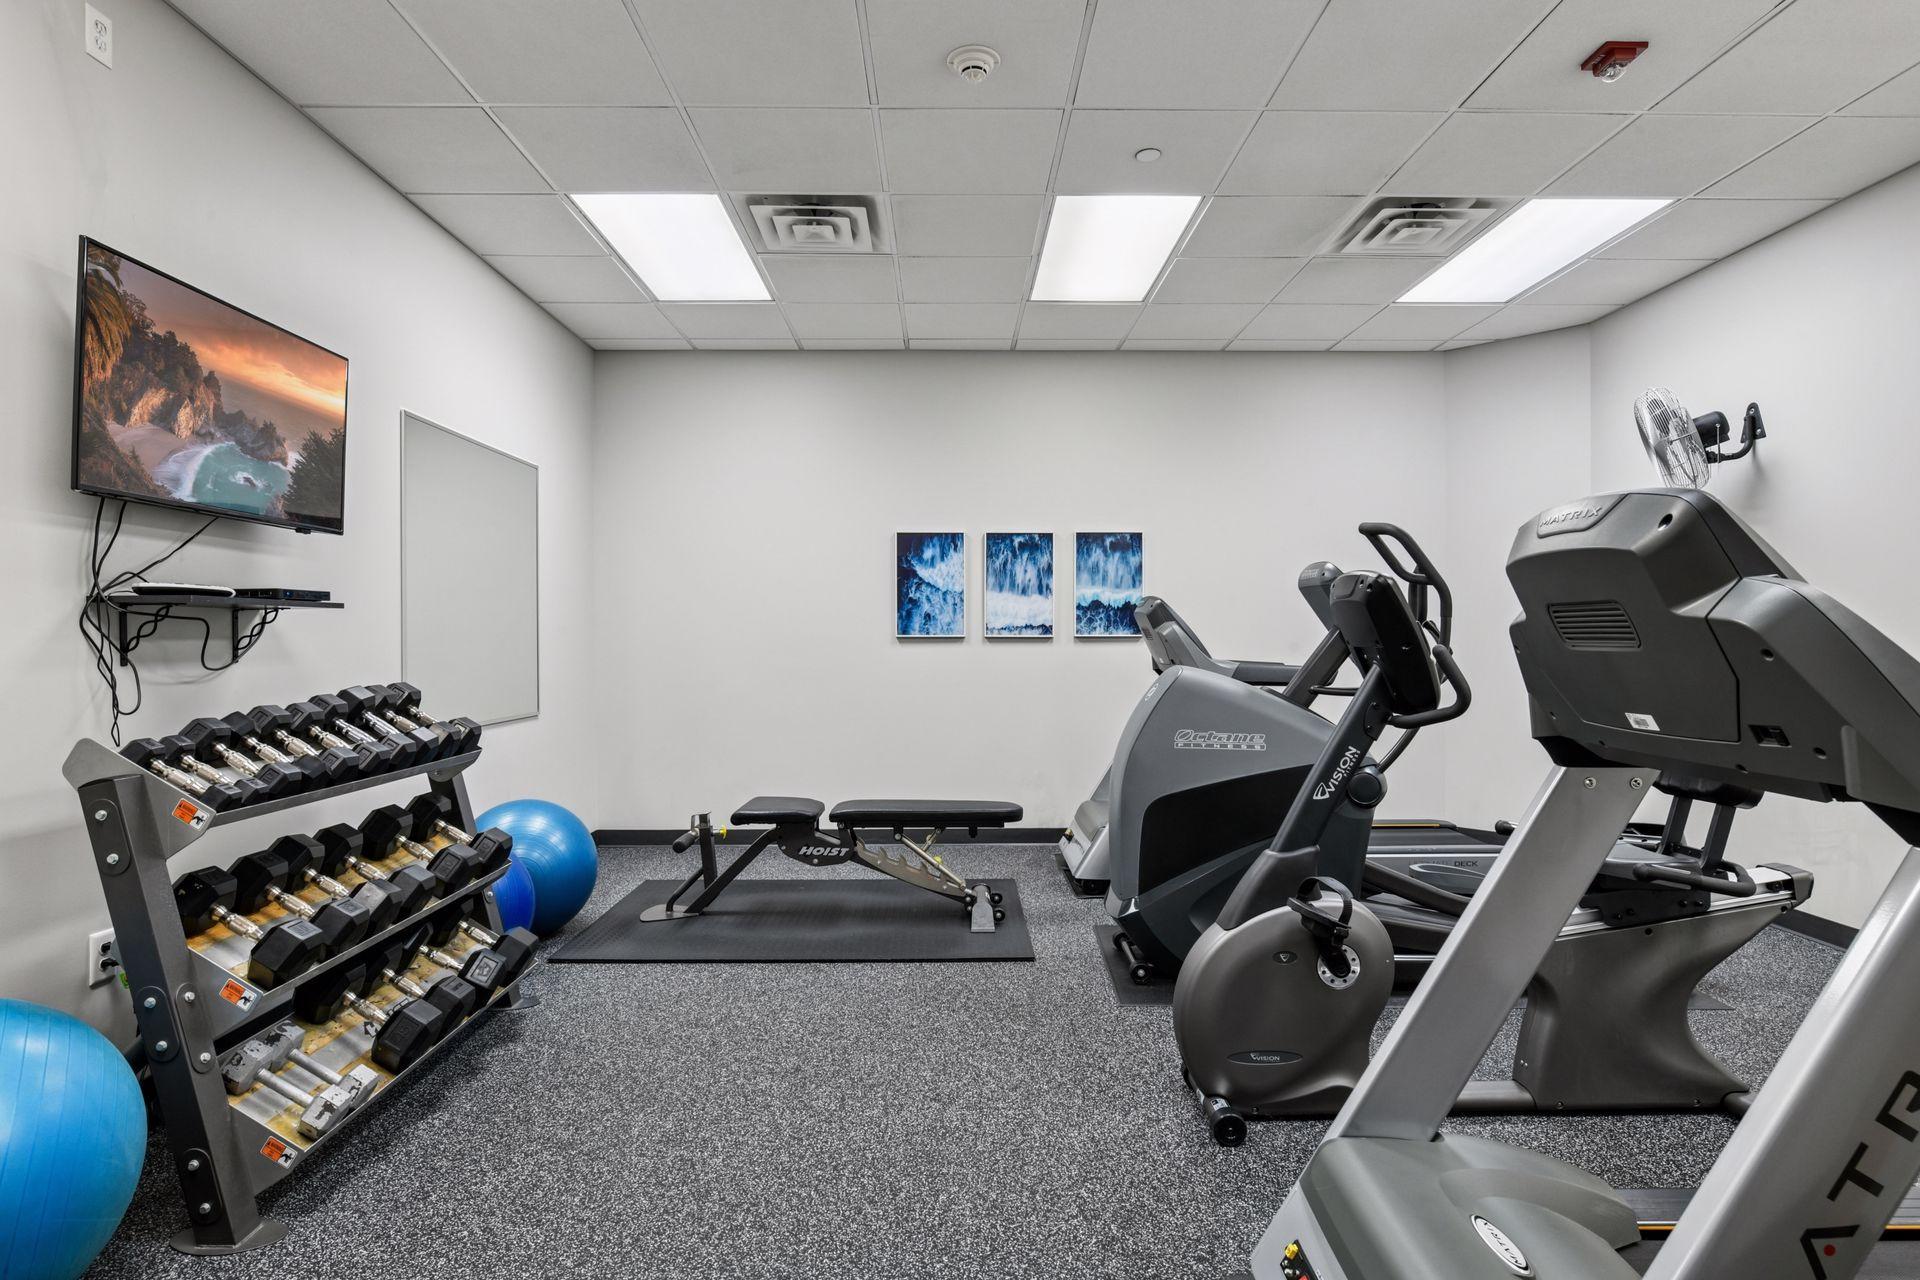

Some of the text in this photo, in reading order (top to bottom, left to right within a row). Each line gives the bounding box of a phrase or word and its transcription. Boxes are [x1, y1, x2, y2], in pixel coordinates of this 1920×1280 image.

[1539, 507, 1602, 528] MATRIX
[1174, 730, 1265, 744] Octane
[1327, 745, 1357, 792] VISION
[798, 846, 850, 857] HOIST
[1454, 860, 1479, 868] DECK
[1483, 1221, 1523, 1267] MATRIX
